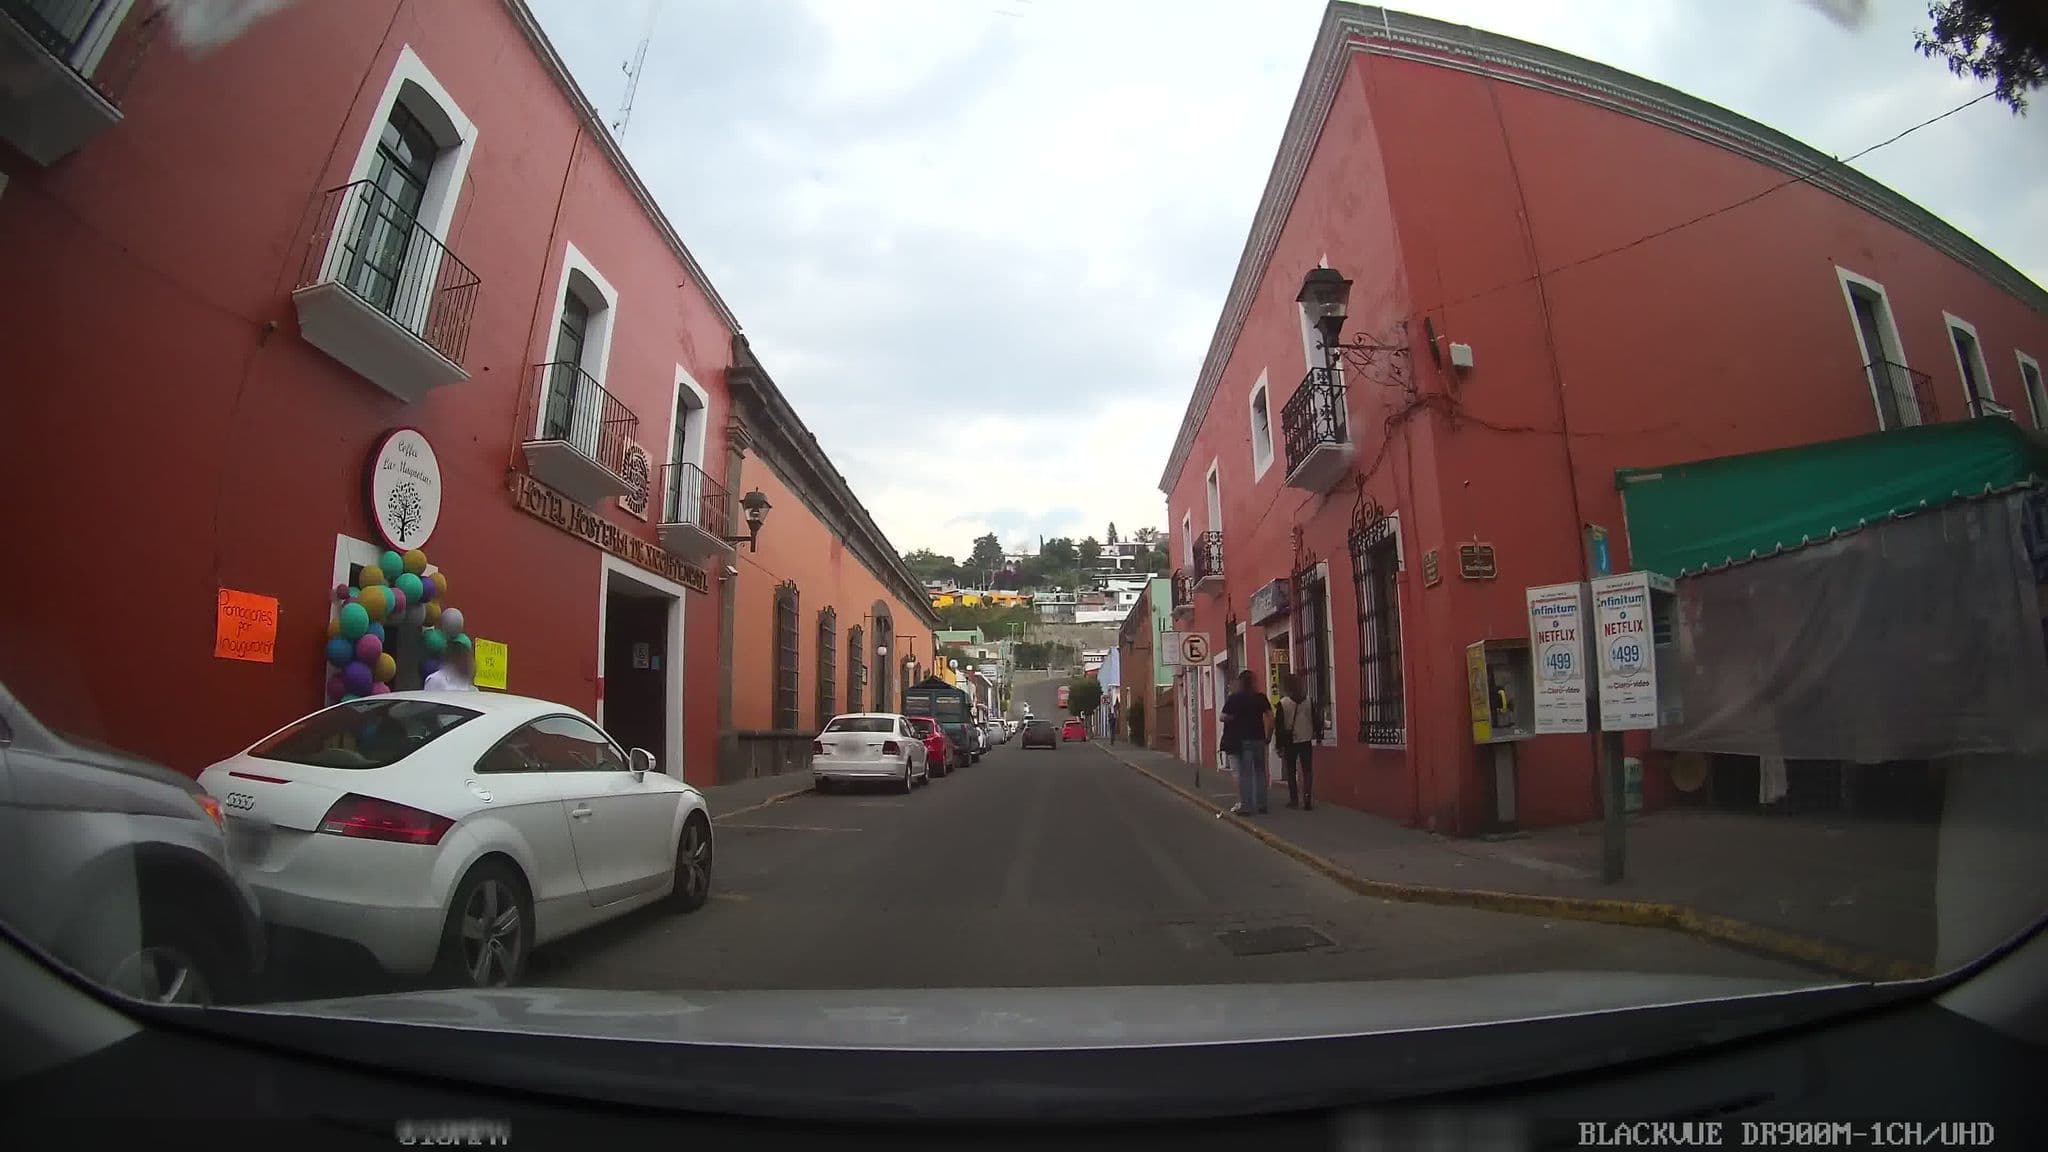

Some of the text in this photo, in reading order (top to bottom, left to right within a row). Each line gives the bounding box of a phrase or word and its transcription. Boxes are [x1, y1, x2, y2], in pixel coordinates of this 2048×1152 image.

[1531, 604, 1577, 615] infinitum
[1604, 620, 1643, 637] NETFLIX
[1537, 629, 1576, 644] NETFLIX
